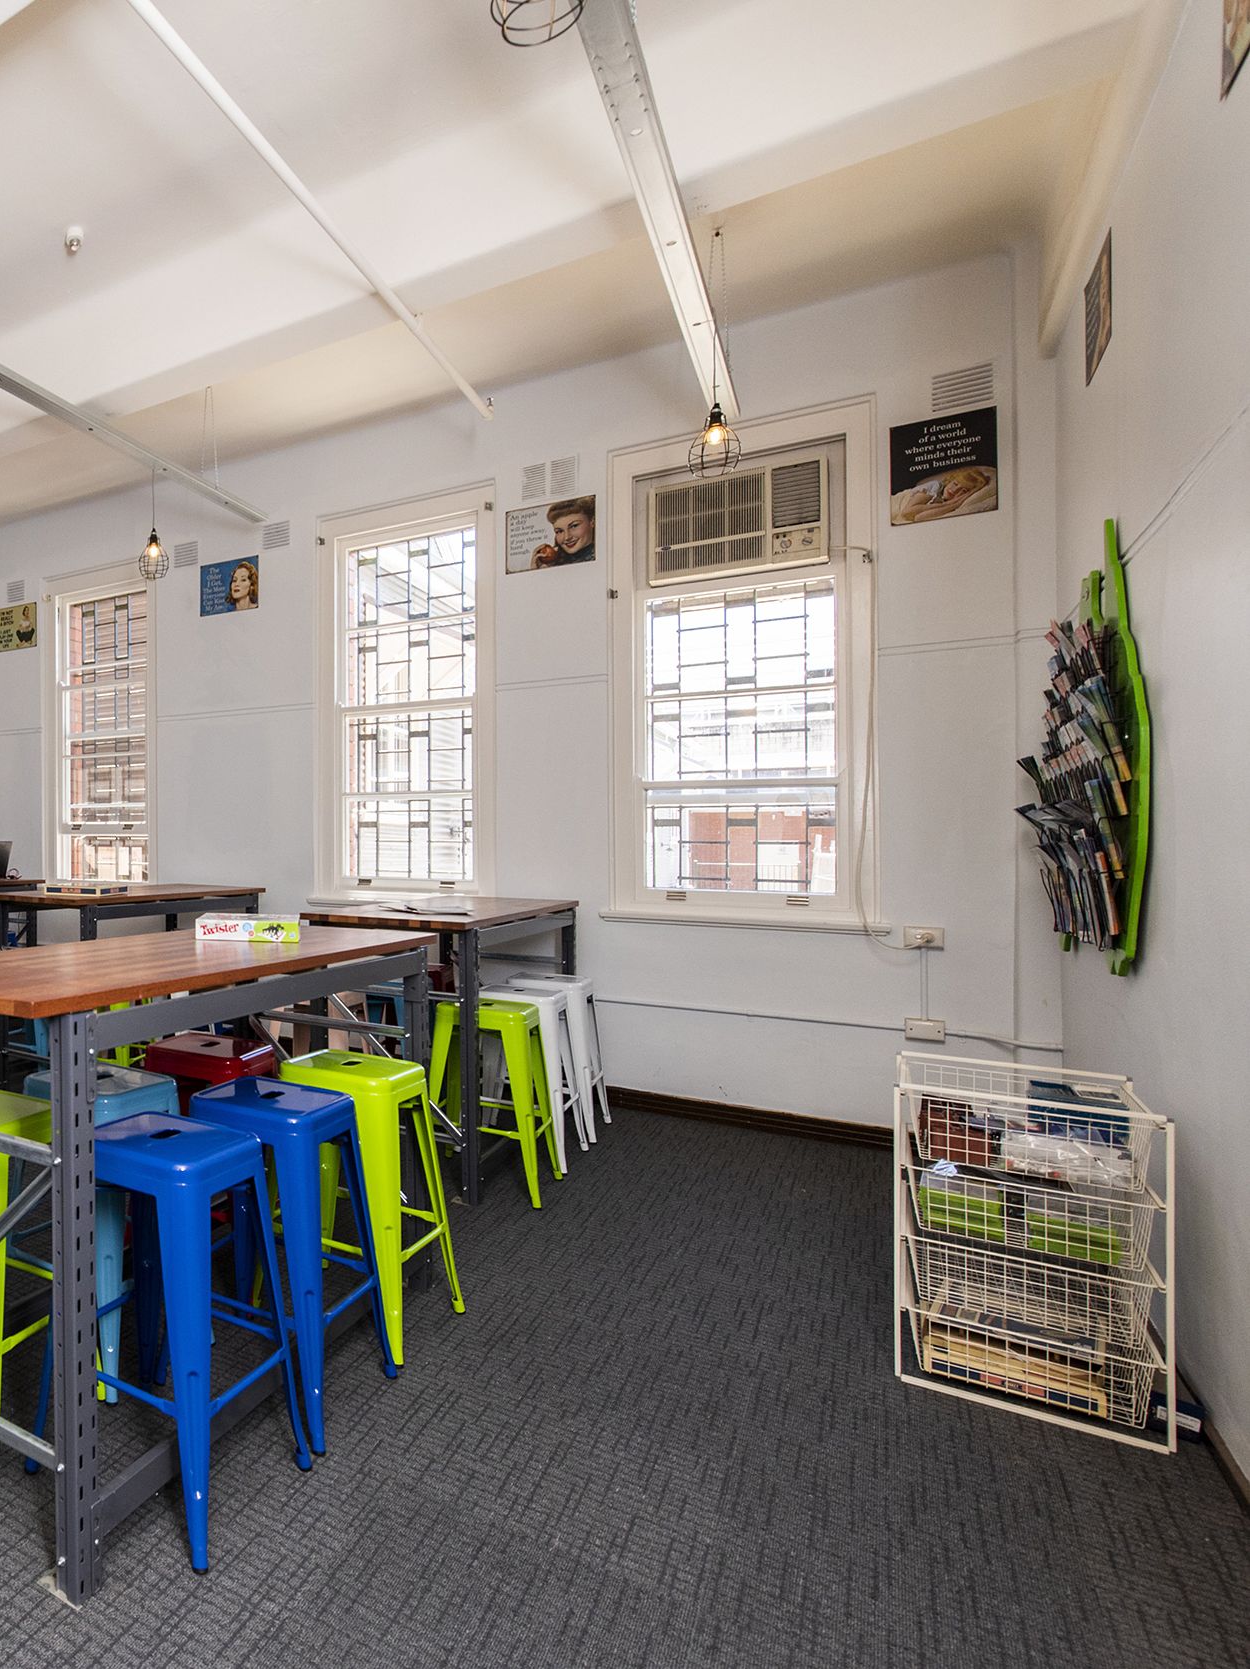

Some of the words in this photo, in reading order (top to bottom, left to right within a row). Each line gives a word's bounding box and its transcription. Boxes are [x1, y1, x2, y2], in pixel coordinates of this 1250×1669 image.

[929, 421, 961, 432] dream
[918, 435, 928, 444] of
[938, 428, 967, 440] world
[905, 444, 934, 455] where
[936, 435, 982, 449] everyone
[915, 451, 945, 462] minds
[947, 446, 972, 456] their
[909, 464, 930, 472] own
[933, 455, 976, 468] business
[521, 511, 538, 520] apple
[200, 923, 239, 936] Twister
